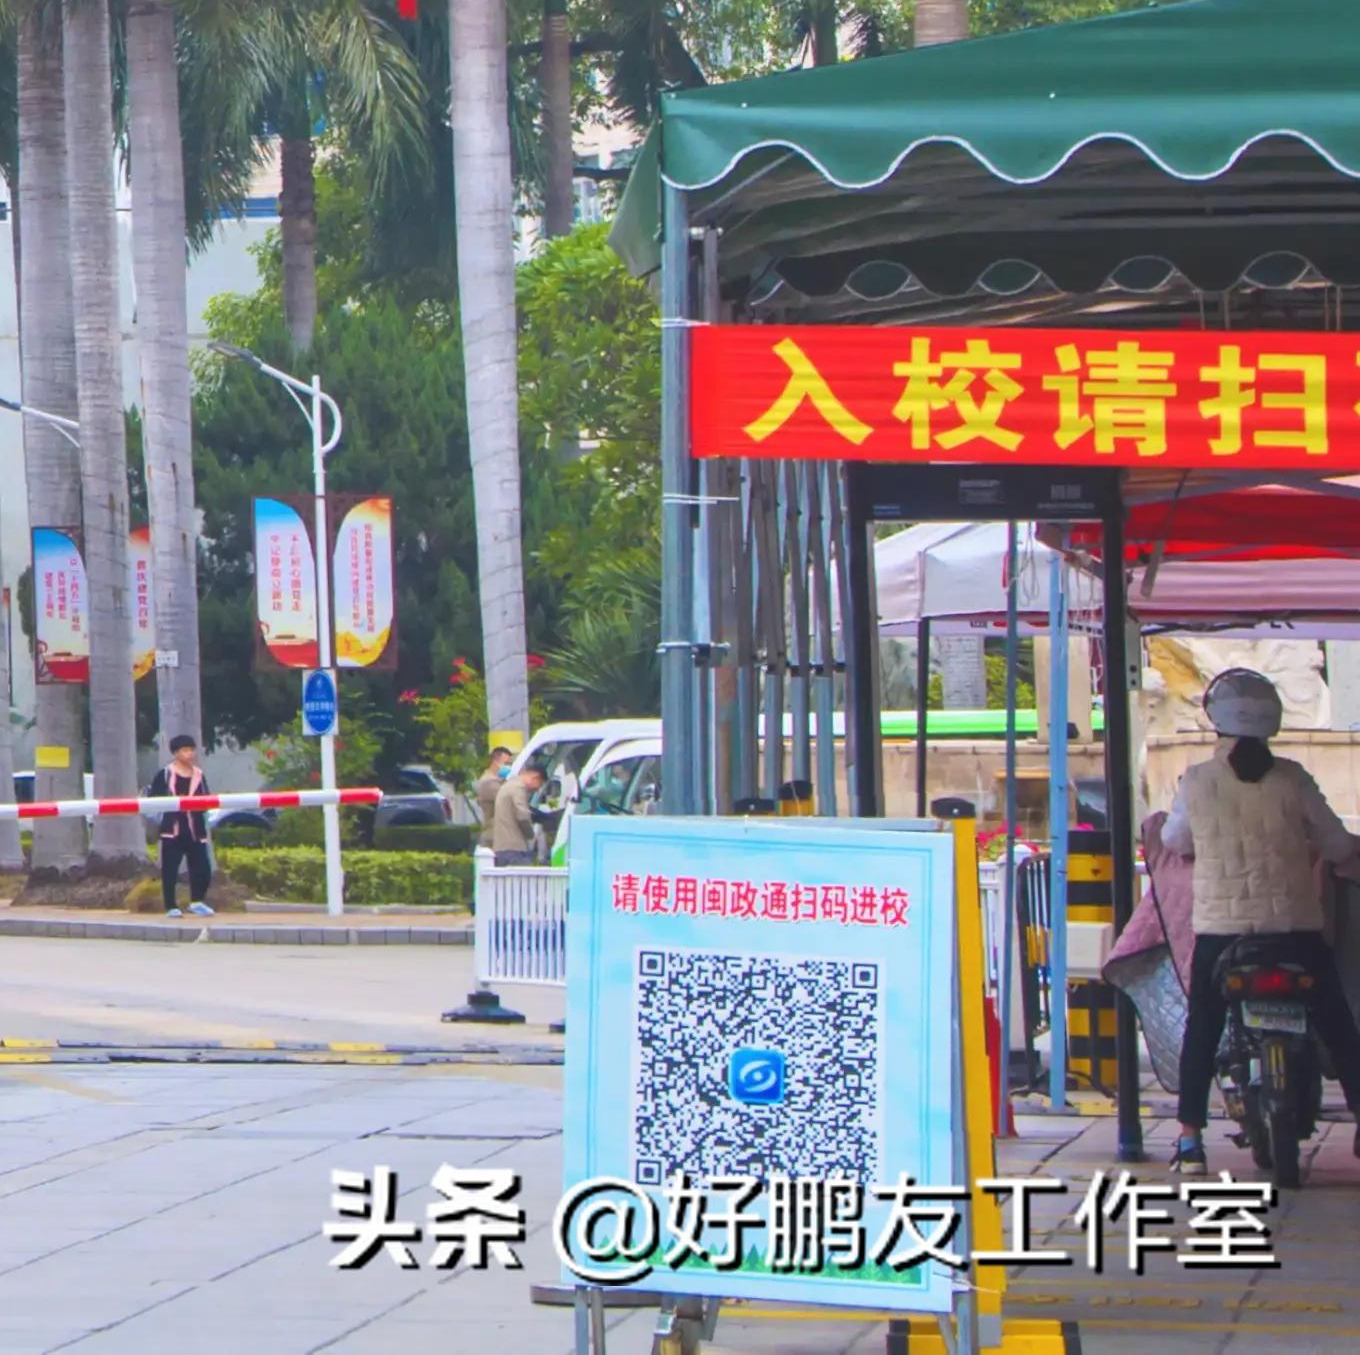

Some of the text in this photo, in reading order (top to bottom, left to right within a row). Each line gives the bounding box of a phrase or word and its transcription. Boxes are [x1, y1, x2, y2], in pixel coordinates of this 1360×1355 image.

[742, 336, 1360, 457] 入校请扫
[611, 872, 910, 929] 请使用闽政通扫码进校
